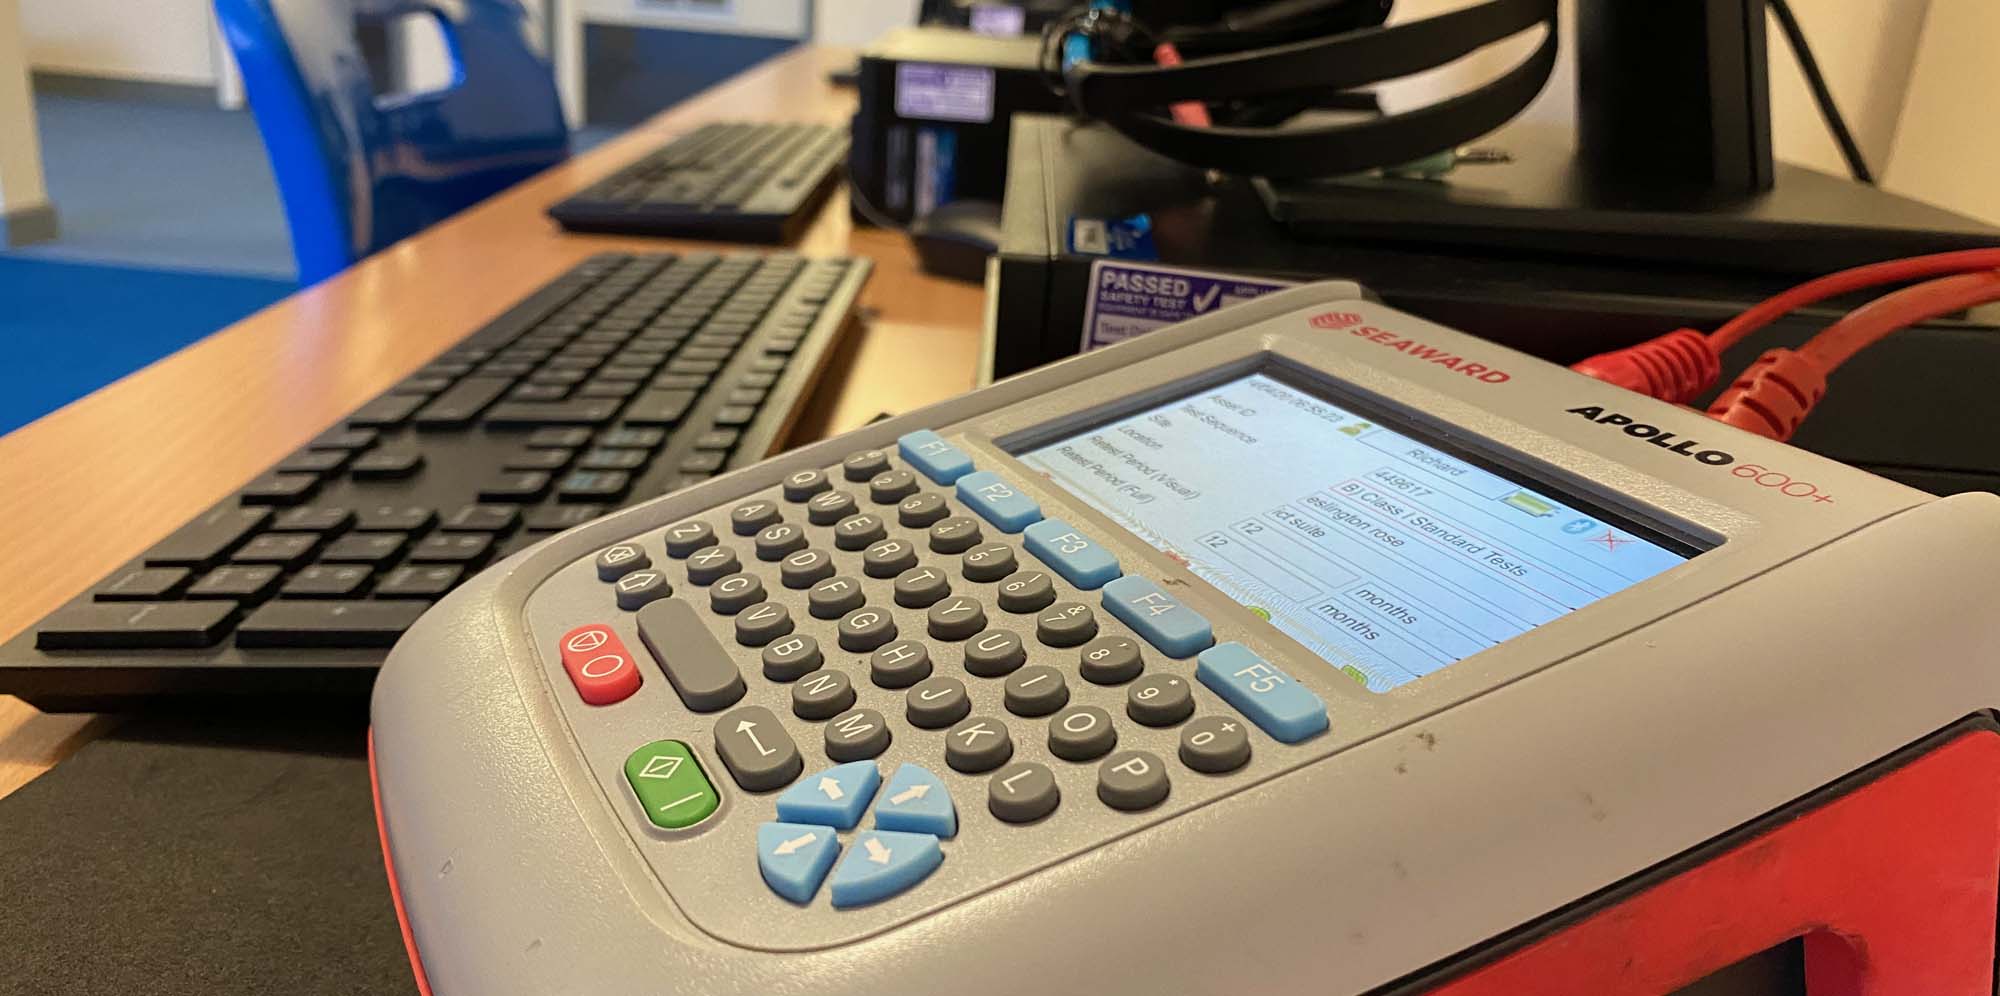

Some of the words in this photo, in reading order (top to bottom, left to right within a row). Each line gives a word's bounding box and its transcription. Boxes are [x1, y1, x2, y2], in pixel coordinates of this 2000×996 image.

[1102, 270, 1190, 297] PASSED
[1100, 291, 1149, 305] SAFETY
[1152, 297, 1186, 309] TEST
[1350, 326, 1510, 384] SEAWARD
[1118, 426, 1163, 450] Location
[1200, 415, 1257, 445] Sequence
[919, 440, 952, 456] F1
[1565, 406, 1734, 465] APOLLO
[1731, 464, 1834, 504] 600+
[1090, 435, 1125, 457] Retest
[1119, 452, 1159, 476] Period
[1150, 469, 1201, 501] (Visual)
[1407, 449, 1468, 476] Richard
[793, 471, 817, 484] Q
[1056, 445, 1092, 468] Retest
[1086, 463, 1126, 487] Period
[1117, 482, 1156, 504] (Full)
[1374, 470, 1432, 498] 449617
[815, 491, 846, 507] W
[977, 481, 1014, 502] F2
[738, 504, 765, 517] A
[903, 500, 922, 509] 3
[673, 524, 702, 538] Z
[844, 516, 872, 530] E
[1239, 521, 1264, 535] 12
[1272, 508, 1296, 520] ict
[1289, 516, 1325, 538] suite
[1306, 495, 1371, 532] eslington
[1368, 526, 1405, 548] rose
[767, 527, 792, 540] S
[1050, 532, 1089, 554] F3
[1205, 535, 1228, 548] 12
[1360, 490, 1405, 516] Class
[1410, 516, 1487, 554] Standard
[1483, 550, 1528, 577] Tests
[695, 548, 725, 565] X
[790, 552, 817, 566] D
[872, 542, 901, 558] R
[720, 577, 748, 592] C
[907, 570, 936, 583] T
[1006, 581, 1025, 591] 6
[818, 580, 848, 594] F
[748, 606, 777, 621] V
[942, 600, 971, 615] Y
[1131, 592, 1175, 618] F4
[1355, 587, 1416, 625] months
[850, 612, 880, 629] G
[1319, 602, 1380, 641] months
[773, 638, 804, 656] B
[976, 632, 1010, 652] U
[881, 644, 916, 664] H
[1089, 648, 1110, 660] 8
[802, 674, 837, 695] N
[1233, 663, 1286, 693] F5
[920, 688, 953, 700] J
[1136, 687, 1160, 699] 9
[834, 713, 874, 738] M
[1063, 712, 1097, 732] O
[959, 722, 995, 746] K
[1111, 757, 1150, 777] P
[1002, 769, 1033, 793] L
